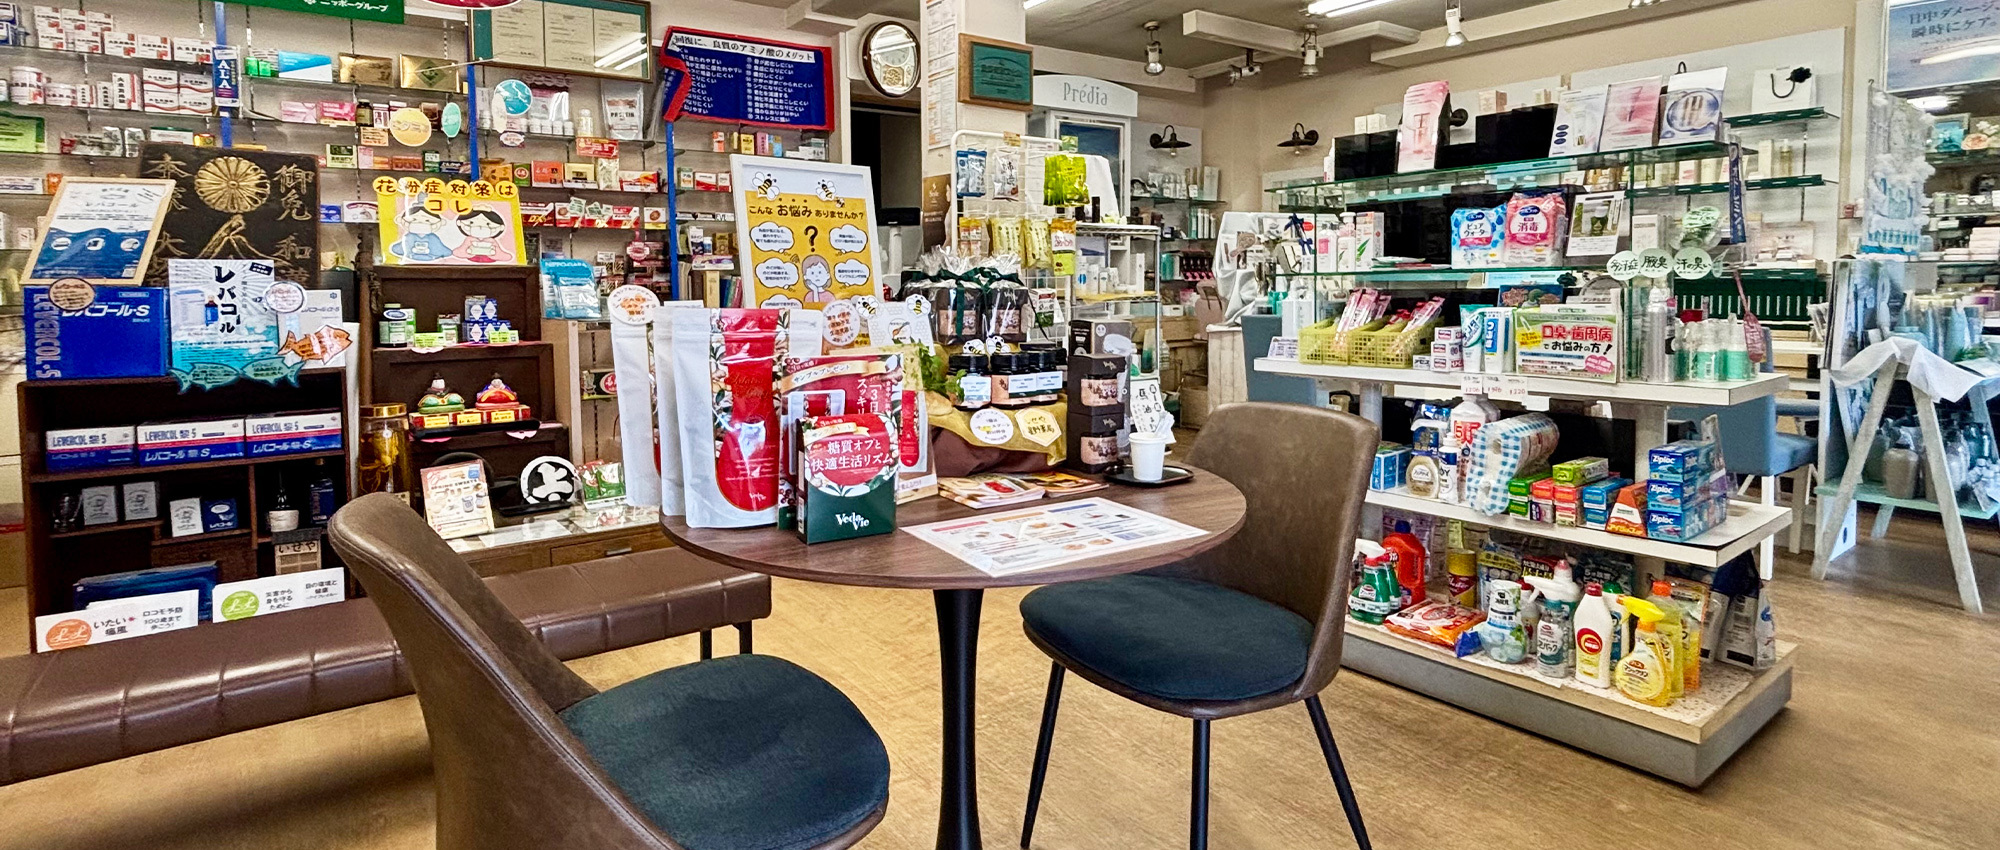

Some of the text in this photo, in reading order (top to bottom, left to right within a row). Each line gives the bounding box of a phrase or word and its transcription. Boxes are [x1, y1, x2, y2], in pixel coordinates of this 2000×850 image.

[217, 59, 232, 89] ALA
[1063, 82, 1108, 106] Prédia
[428, 199, 469, 213] コレ
[748, 205, 773, 215] こんな
[776, 204, 813, 217] お悩み
[1542, 324, 1613, 342] 口臭・歯周病
[811, 452, 894, 472] 快適生活リズム
[1653, 455, 1675, 464] Ziploc
[1651, 484, 1674, 494] Ziploc
[1651, 514, 1674, 524] Ziploc
[278, 541, 316, 554] いせや
[269, 602, 290, 611] ために
[94, 617, 127, 630] いたい
